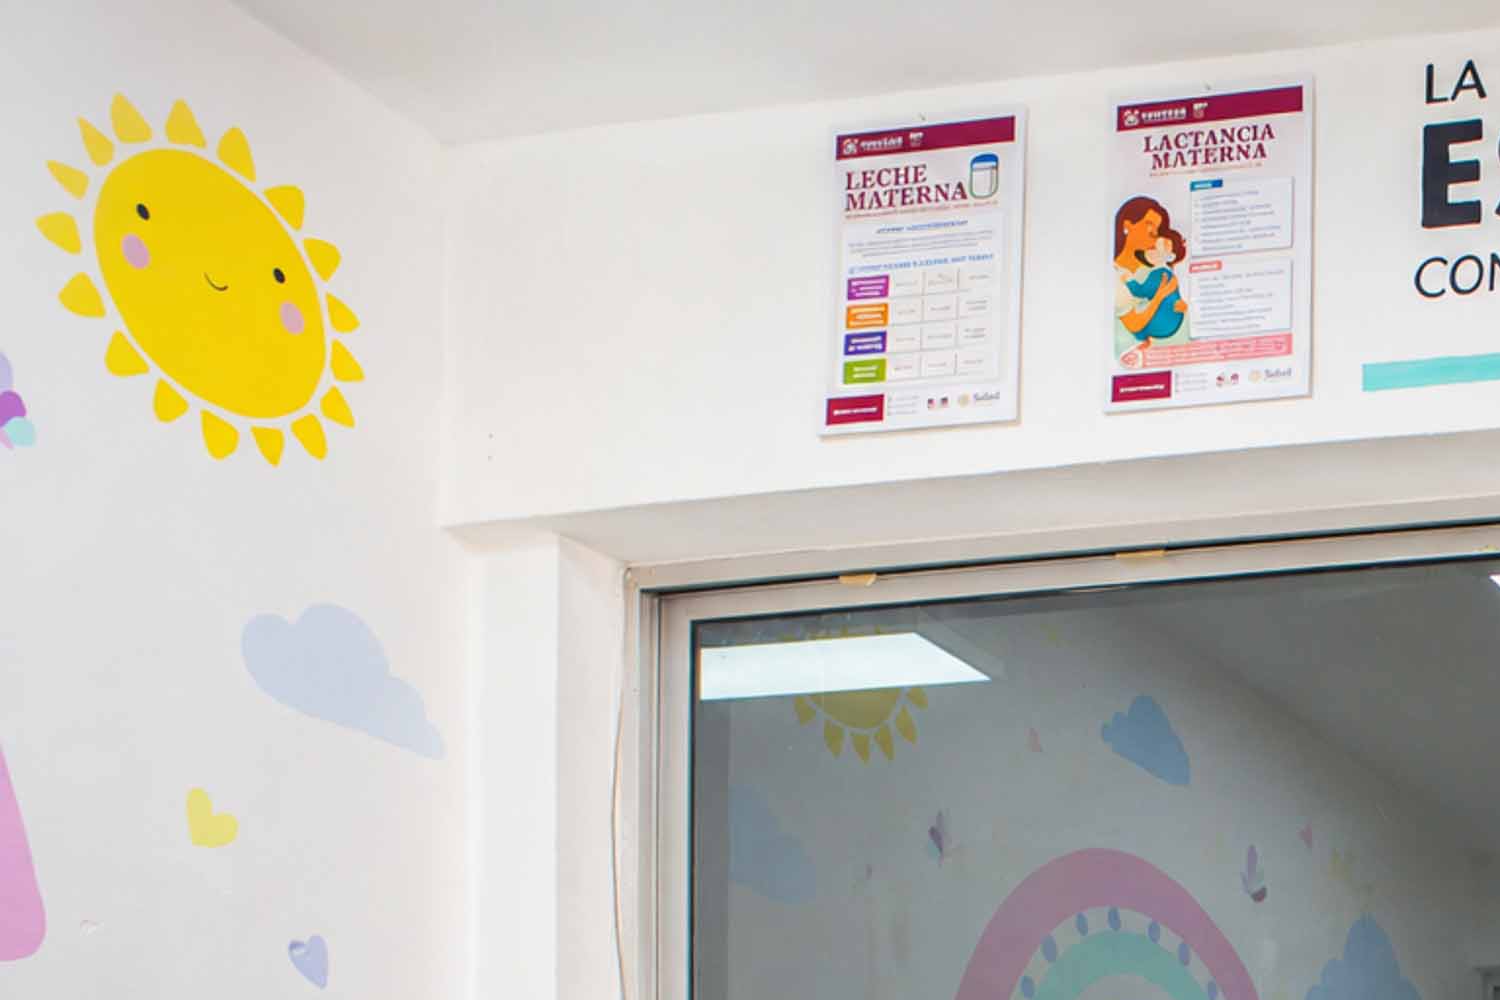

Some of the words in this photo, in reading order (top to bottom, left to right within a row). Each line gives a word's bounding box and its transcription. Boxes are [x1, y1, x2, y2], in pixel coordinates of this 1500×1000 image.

[1425, 59, 1487, 105] LA
[1143, 123, 1276, 153] LACTANCIA
[1151, 143, 1267, 170] MATERNA
[845, 164, 927, 191] LECHE
[844, 181, 968, 212] MATERNA
